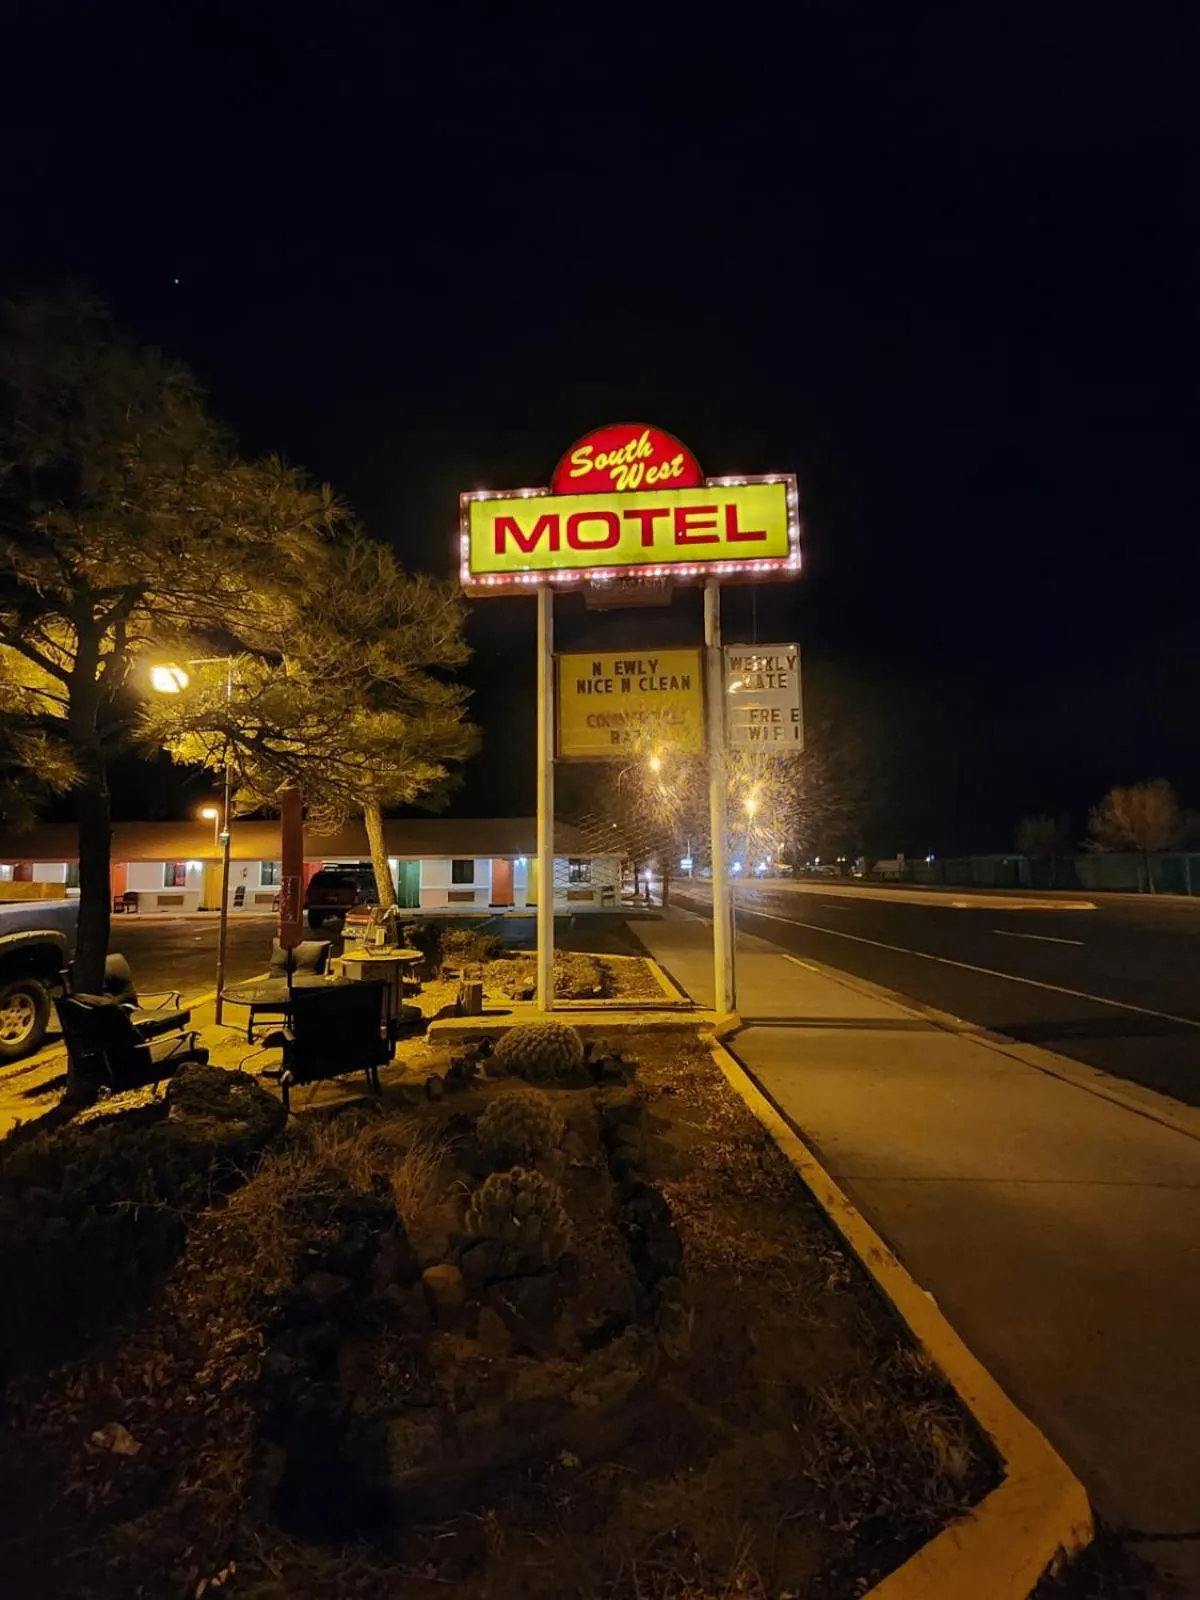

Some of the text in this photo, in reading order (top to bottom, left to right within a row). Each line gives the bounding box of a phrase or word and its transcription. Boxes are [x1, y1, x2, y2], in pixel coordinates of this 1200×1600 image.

[570, 430, 653, 478] South
[609, 453, 684, 492] West
[494, 504, 767, 555] MOTEL
[576, 679, 613, 694] NICE
[638, 676, 691, 691] CLEAN
